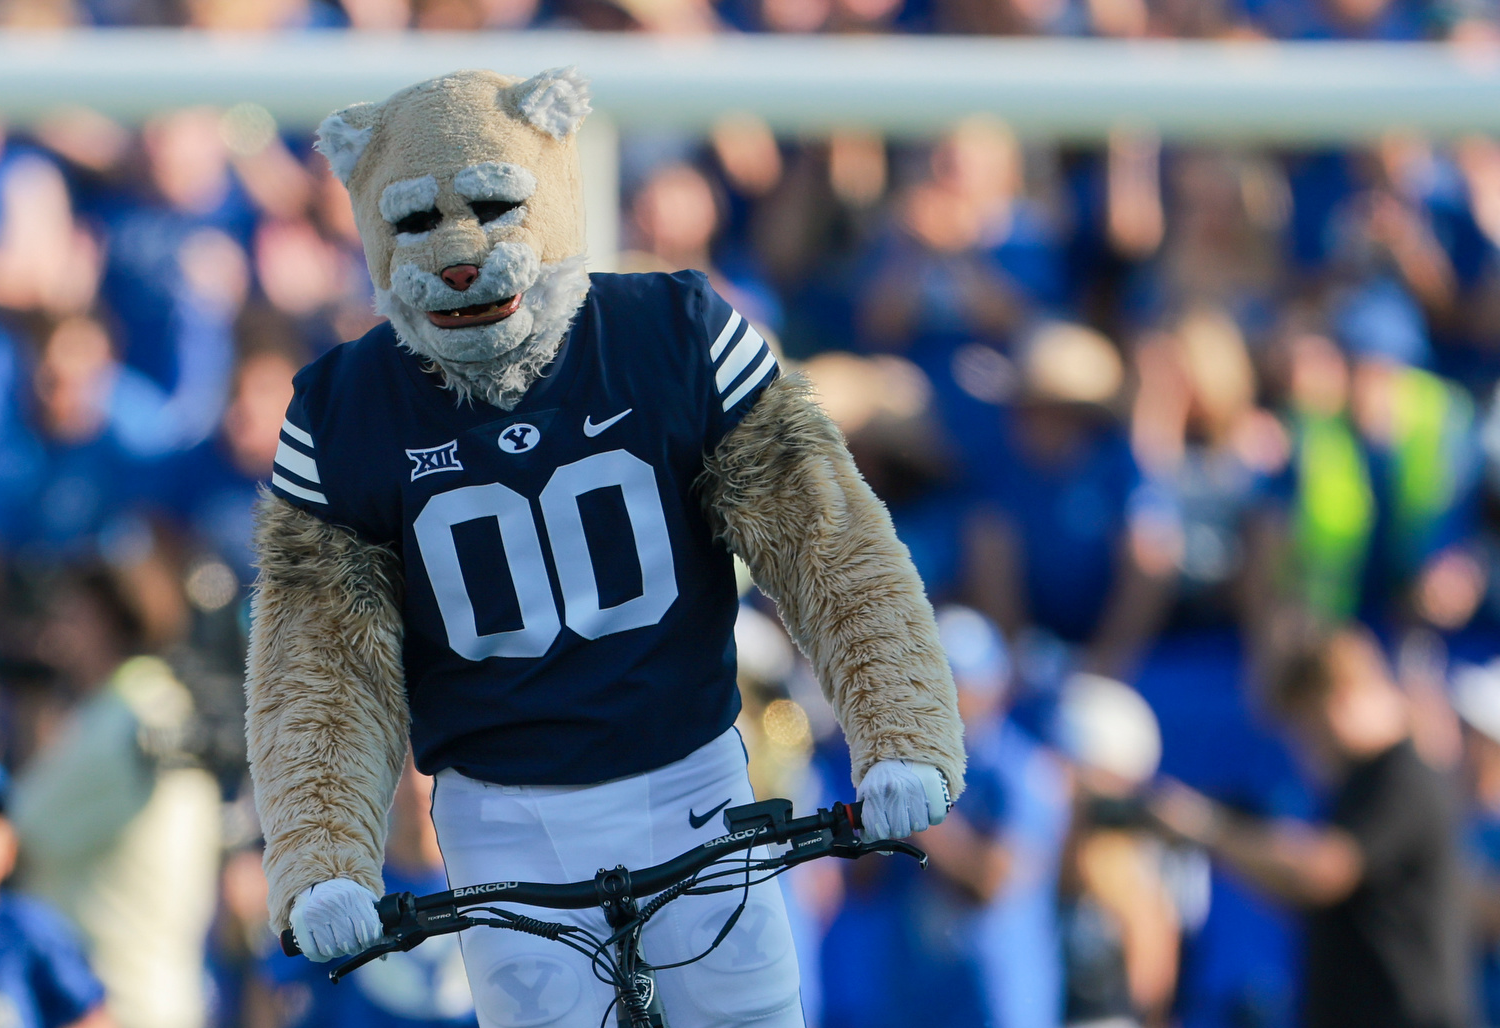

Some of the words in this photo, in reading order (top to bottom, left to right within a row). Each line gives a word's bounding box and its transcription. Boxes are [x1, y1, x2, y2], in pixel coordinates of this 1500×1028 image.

[503, 427, 532, 451] Y
[408, 442, 460, 478] XII
[413, 448, 679, 661] 00
[703, 826, 768, 848] BAKCOU
[453, 881, 519, 898] BAKCOU
[486, 961, 564, 1021] Y
